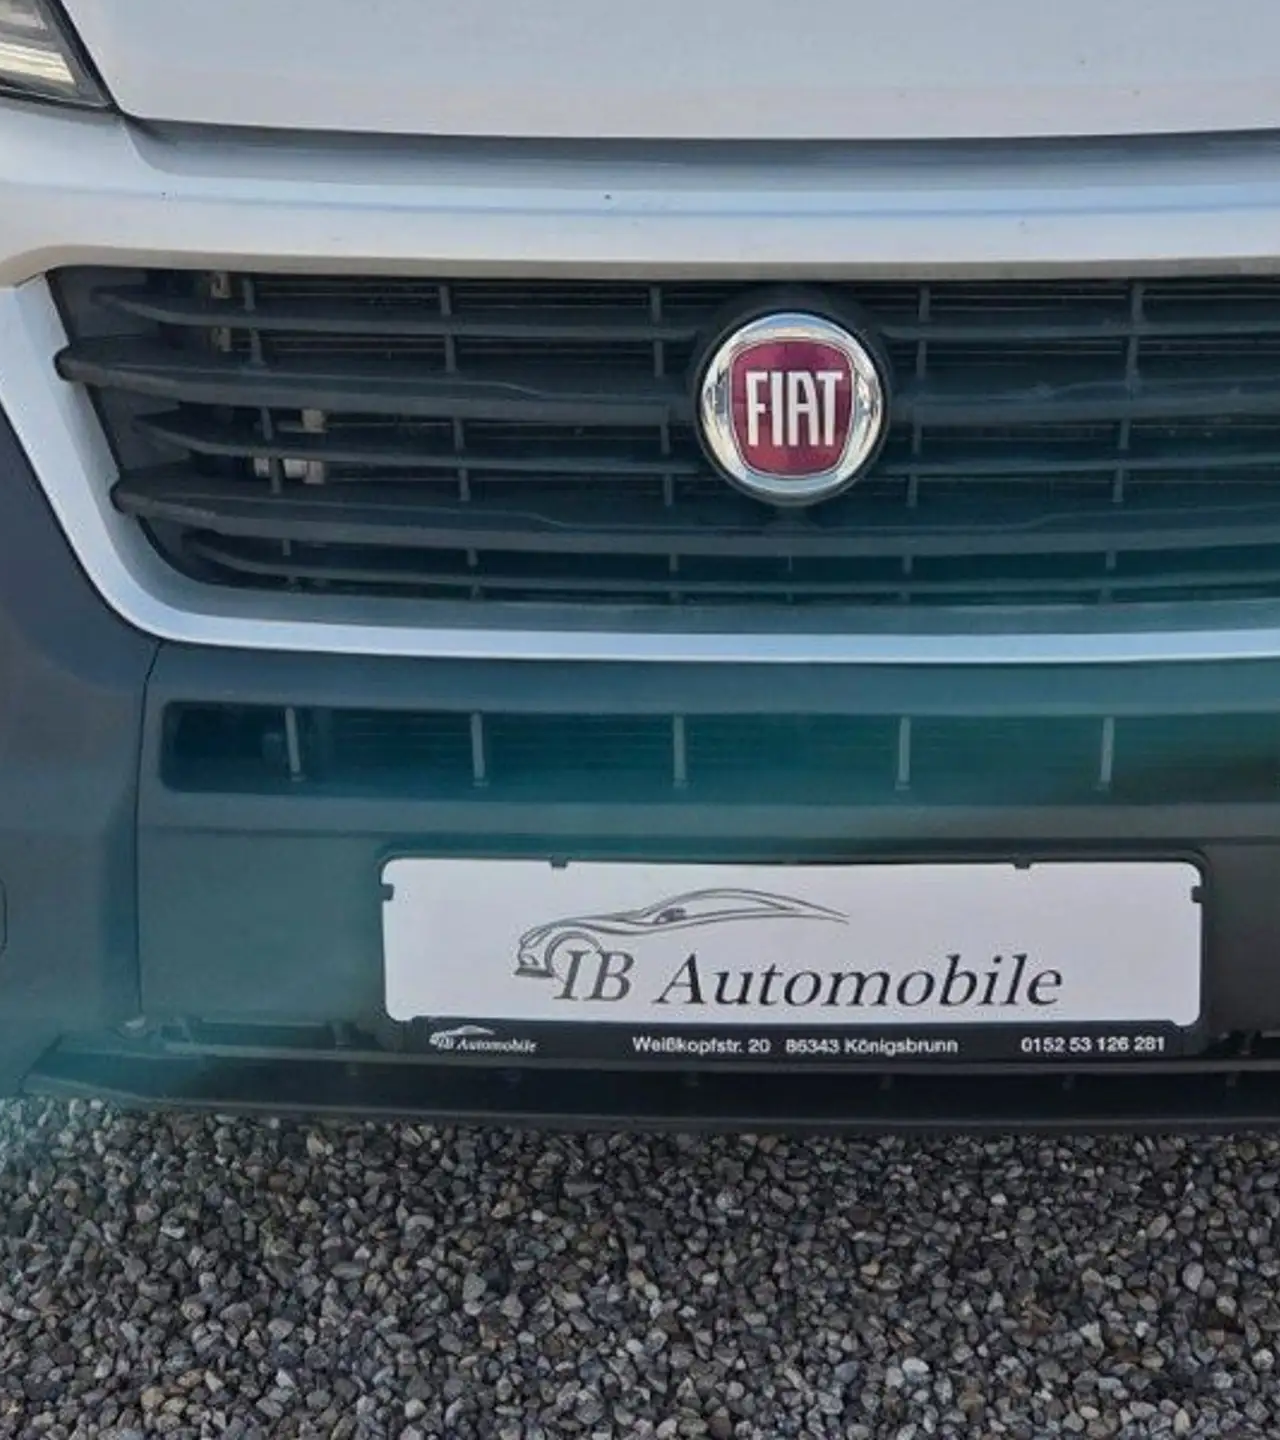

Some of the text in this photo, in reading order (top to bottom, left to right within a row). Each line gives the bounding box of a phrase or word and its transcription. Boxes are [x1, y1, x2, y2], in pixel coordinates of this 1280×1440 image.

[744, 370, 845, 447] FIAT
[651, 952, 1063, 1008] Automobile
[456, 1037, 539, 1053] Automobile
[632, 1036, 743, 1056] Weißkopfstr.
[748, 1038, 771, 1054] 20
[844, 1036, 959, 1057] Königsbrunn
[1021, 1035, 1165, 1053] 0152 53 126 281
